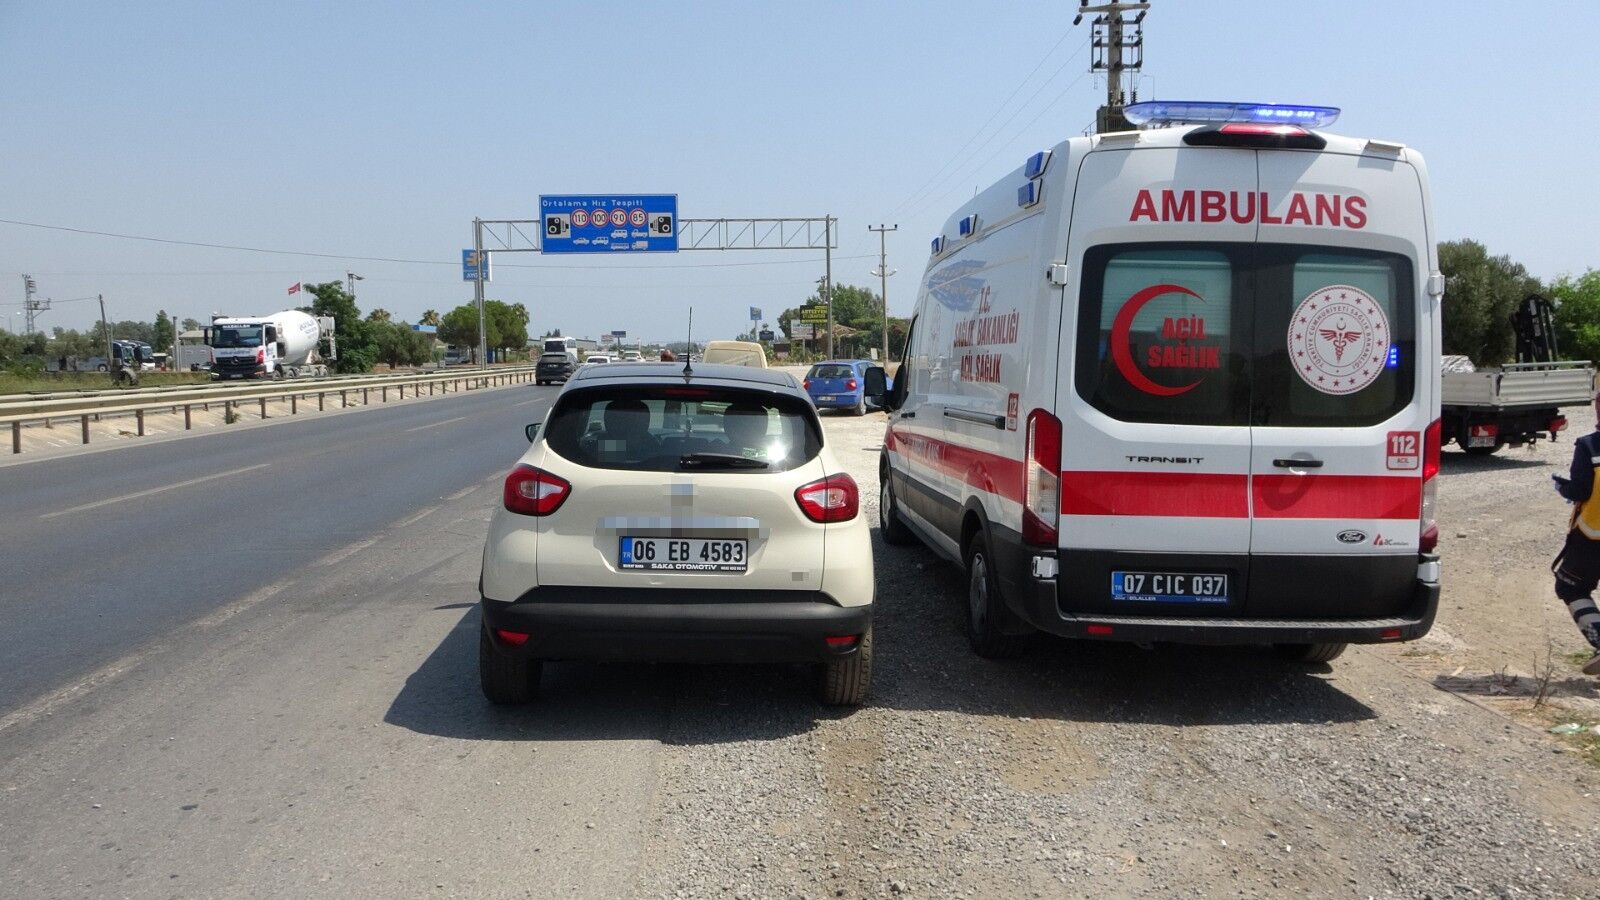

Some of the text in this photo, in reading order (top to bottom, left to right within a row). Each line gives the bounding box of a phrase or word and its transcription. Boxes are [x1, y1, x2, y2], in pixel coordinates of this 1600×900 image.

[542, 199, 588, 207] Ortalama
[611, 199, 643, 208] Tespiti
[1129, 189, 1367, 229] AMBULANS
[574, 213, 587, 221] 110
[632, 212, 644, 220] 85
[977, 307, 1019, 346] BAKANLIĞI
[1147, 340, 1221, 369] SAĞLIK
[975, 351, 1002, 383] SAĞLIK
[1391, 435, 1416, 454] 112
[1125, 455, 1204, 464] TRANSIT
[633, 540, 656, 561] 06
[668, 541, 690, 562] EB
[699, 541, 744, 563] 4583
[1124, 575, 1146, 594] 07
[1152, 575, 1185, 595] CIC
[1192, 576, 1224, 596] 037
